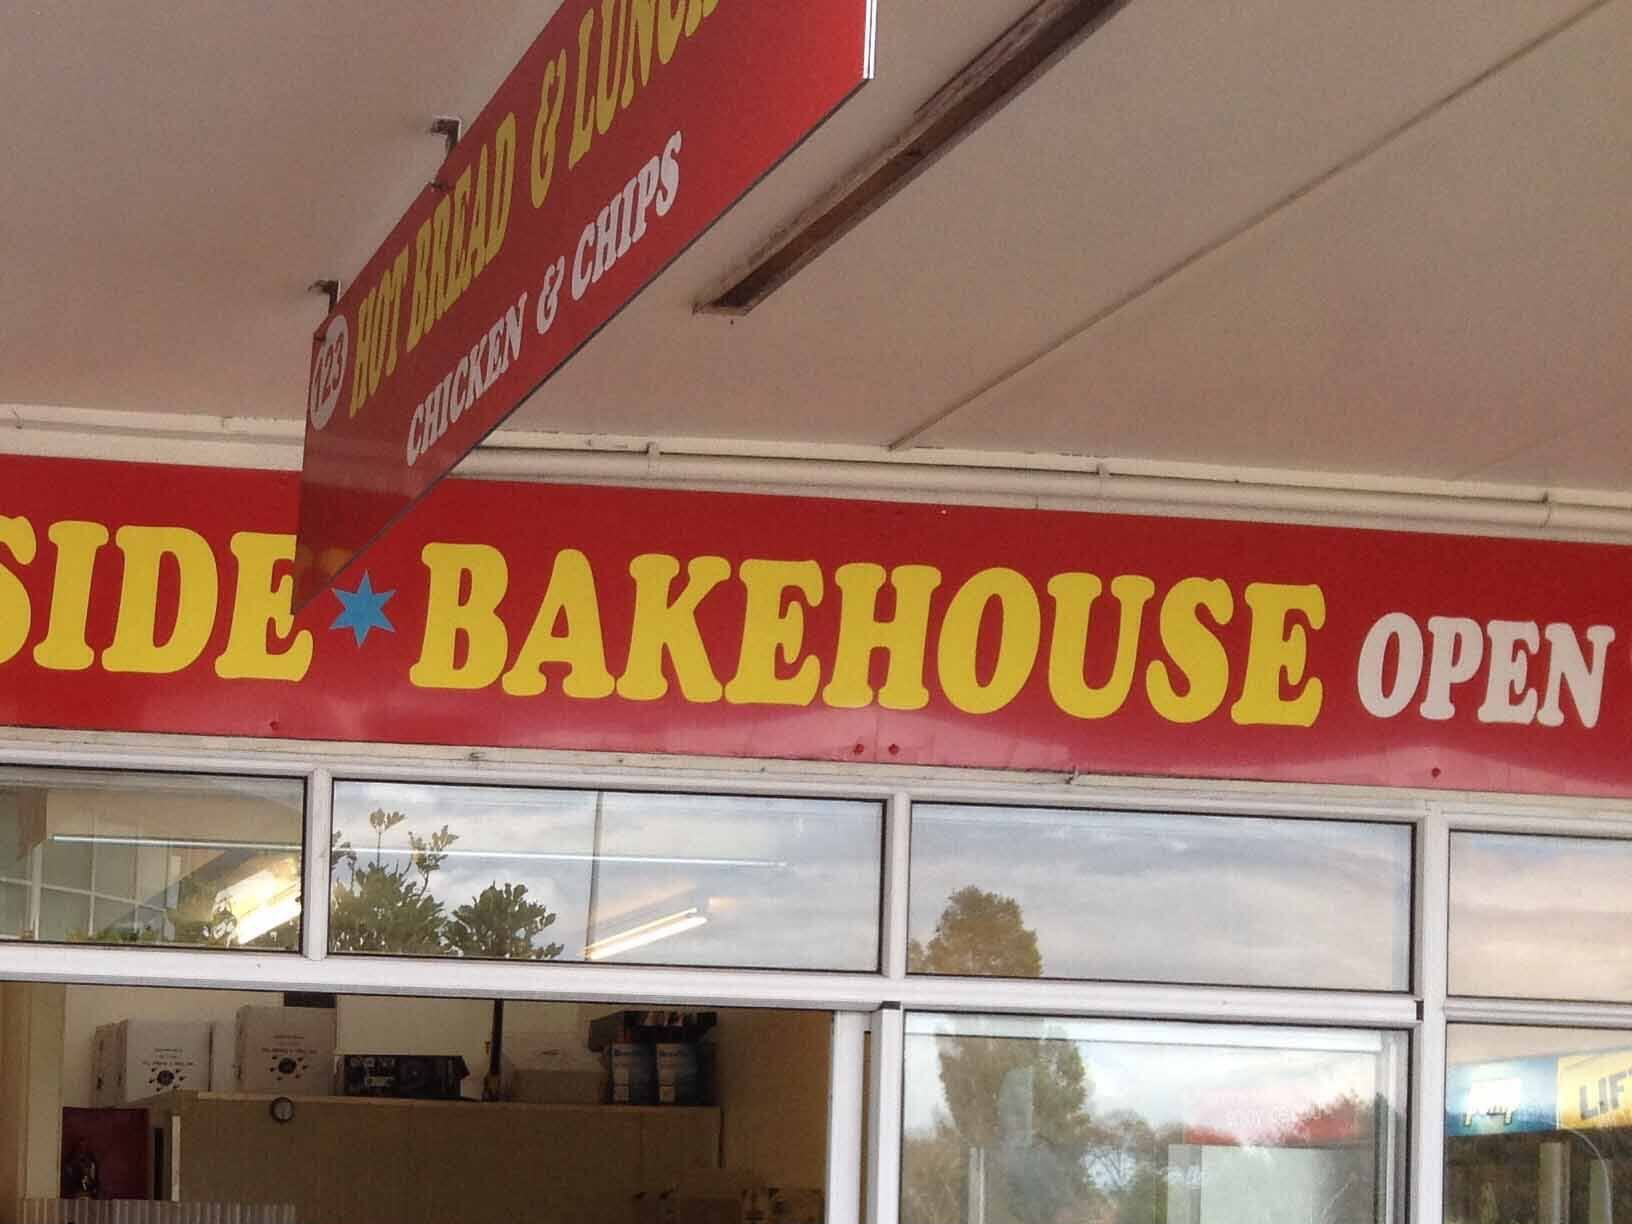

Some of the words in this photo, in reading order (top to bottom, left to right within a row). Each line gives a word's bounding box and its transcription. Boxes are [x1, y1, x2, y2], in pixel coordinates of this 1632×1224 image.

[349, 242, 409, 418] HOT
[406, 112, 517, 352] BREAD
[531, 48, 567, 208] &
[569, 0, 718, 171] LUN
[314, 331, 345, 412] 123
[406, 291, 527, 466] CHICKEN
[536, 255, 566, 335] &
[571, 130, 682, 300] CHIPS
[409, 541, 1326, 727] BAKEHOUSE
[1356, 611, 1615, 728] OPEN
[1579, 1068, 1632, 1120] LIF
